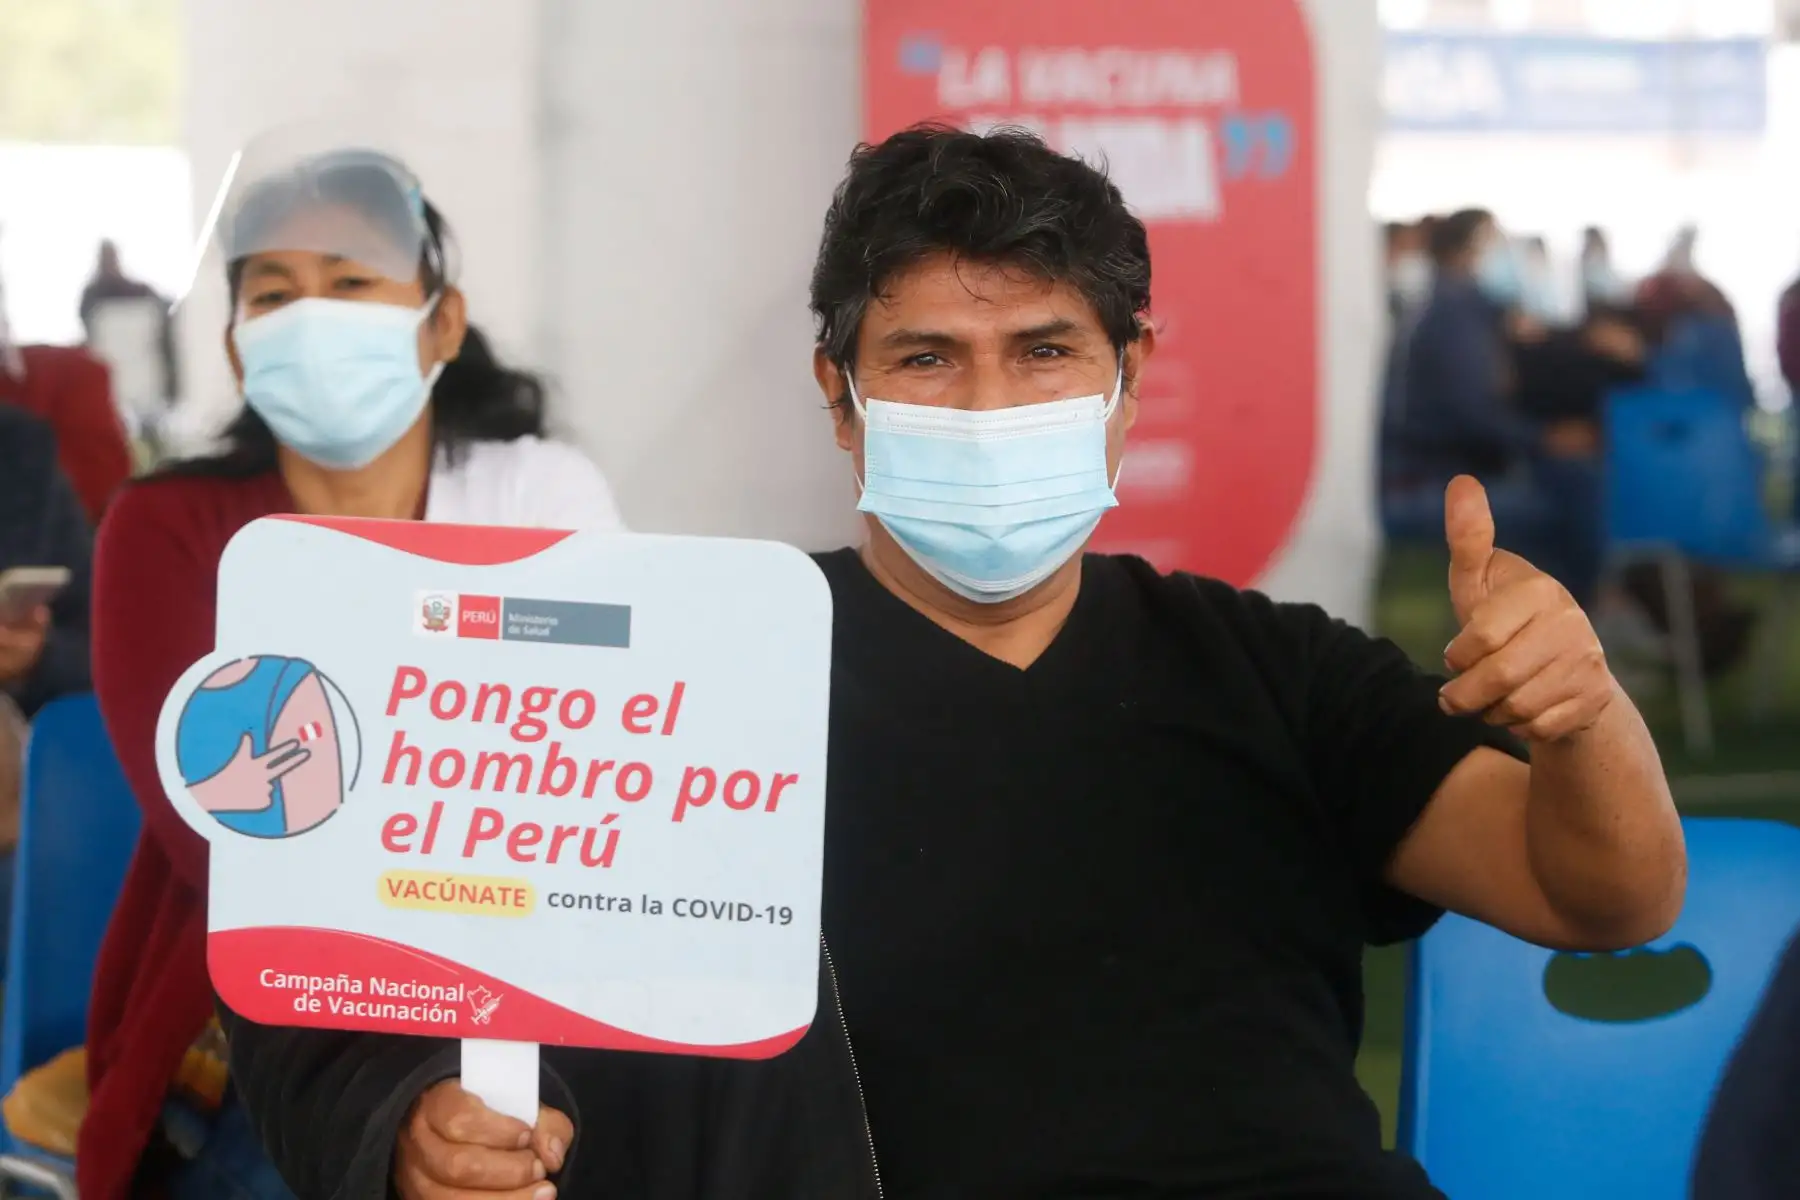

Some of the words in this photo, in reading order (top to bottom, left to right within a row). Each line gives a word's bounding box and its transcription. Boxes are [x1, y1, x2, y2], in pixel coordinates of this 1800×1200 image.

[462, 608, 497, 625] PERÚ
[508, 612, 558, 626] Ministerio
[508, 624, 521, 635] de
[523, 624, 550, 637] Salud
[385, 665, 597, 744] Pongo
[620, 681, 686, 736] el
[383, 729, 654, 803] hombro
[671, 765, 800, 823] por
[380, 799, 445, 855] el
[463, 806, 621, 869] Perú
[386, 878, 526, 908] VACÚNATE
[547, 892, 632, 913] contra
[641, 894, 663, 915] la
[672, 898, 793, 926] COVID-19
[260, 968, 363, 996] Campaña
[369, 976, 464, 1002] Nacional
[293, 992, 322, 1013] de
[327, 995, 457, 1024] Vacunación
